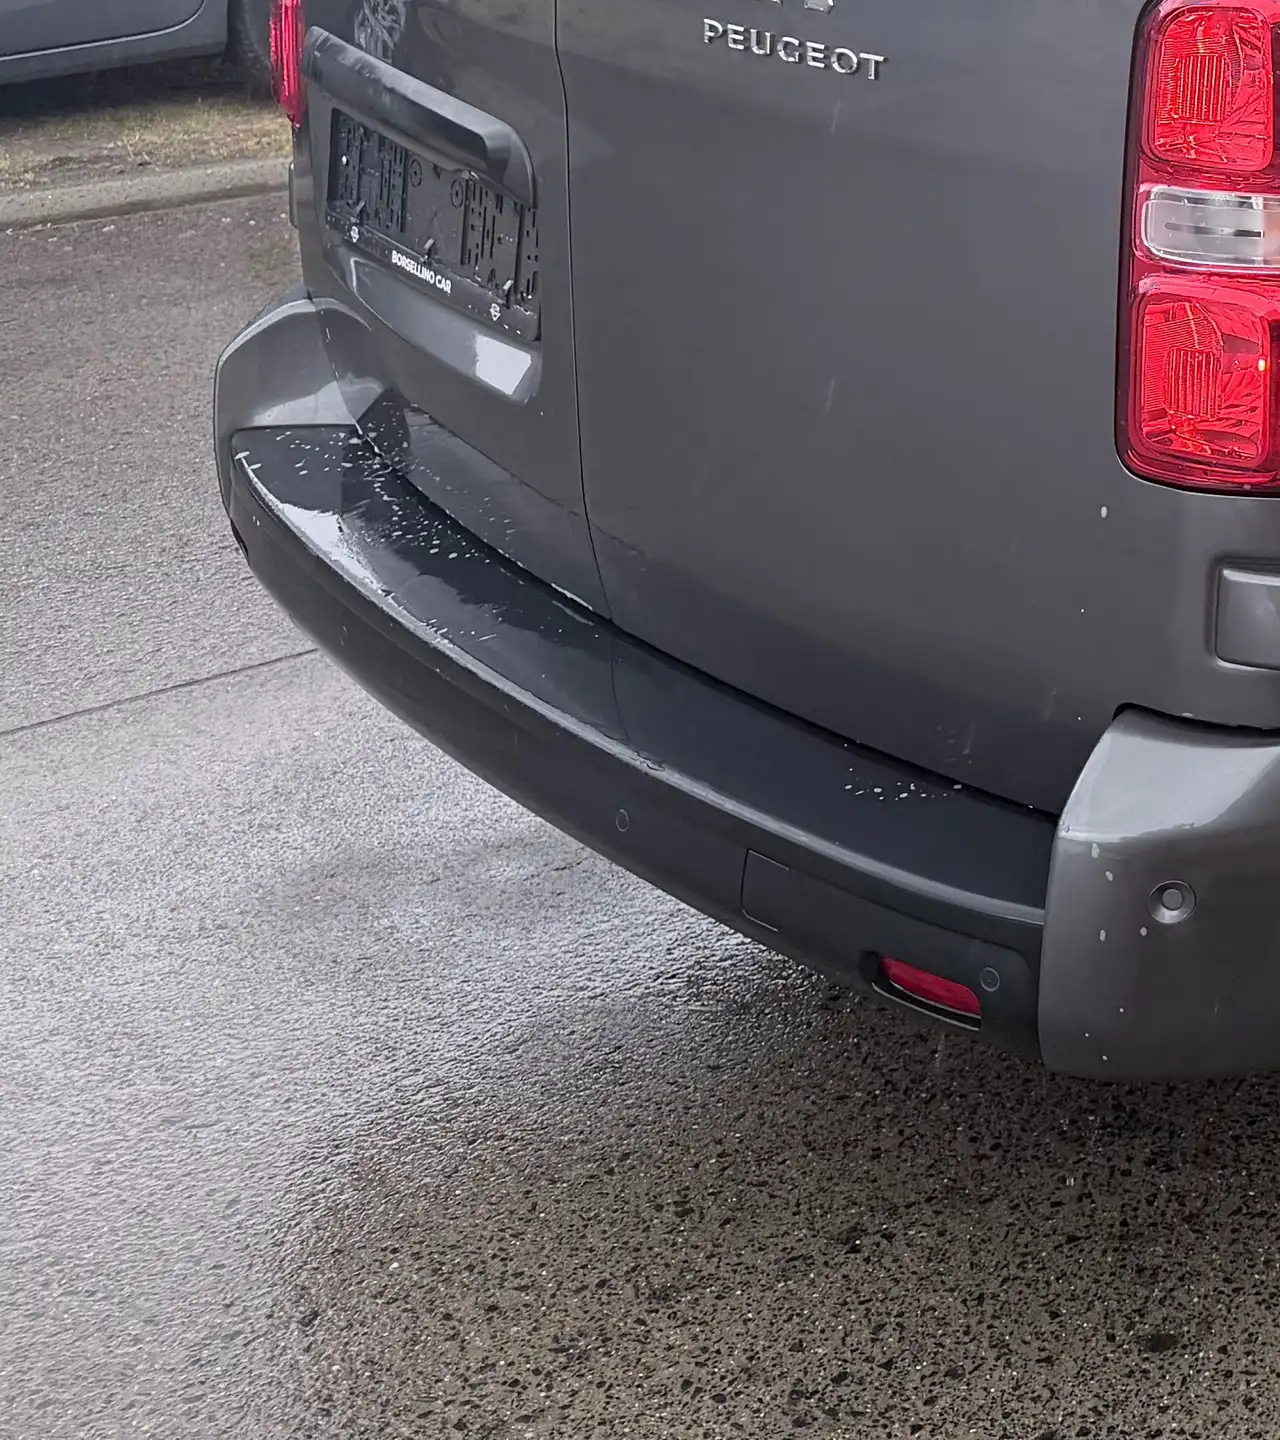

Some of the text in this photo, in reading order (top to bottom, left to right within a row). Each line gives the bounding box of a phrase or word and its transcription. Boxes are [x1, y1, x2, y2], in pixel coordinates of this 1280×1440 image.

[703, 18, 888, 80] PEUGEOT
[391, 250, 452, 294] BORSELLINO CAR
